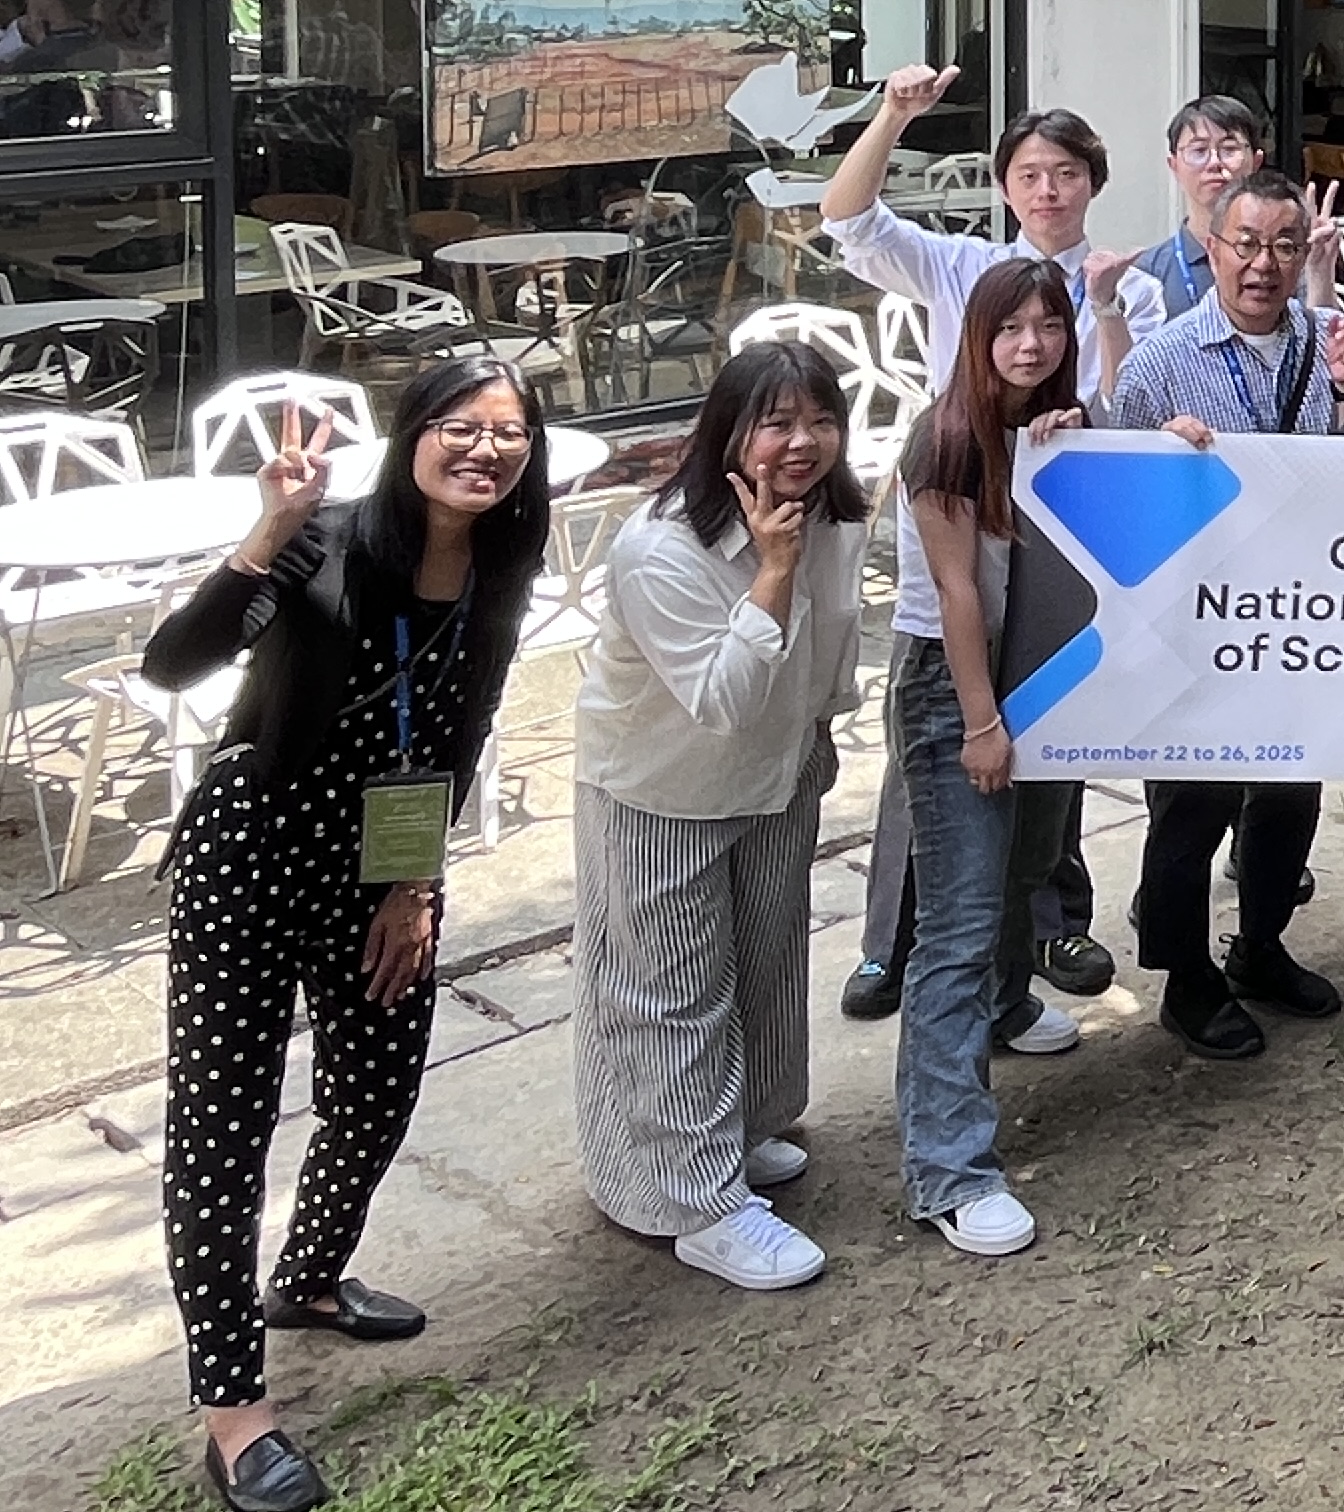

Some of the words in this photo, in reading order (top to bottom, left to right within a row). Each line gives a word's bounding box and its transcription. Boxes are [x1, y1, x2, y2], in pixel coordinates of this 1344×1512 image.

[1212, 632, 1270, 673] of
[1040, 744, 1159, 764] September
[1163, 745, 1188, 762] 22
[1194, 745, 1216, 762] to
[1219, 745, 1250, 764] 26,
[1254, 744, 1305, 762] 2025
